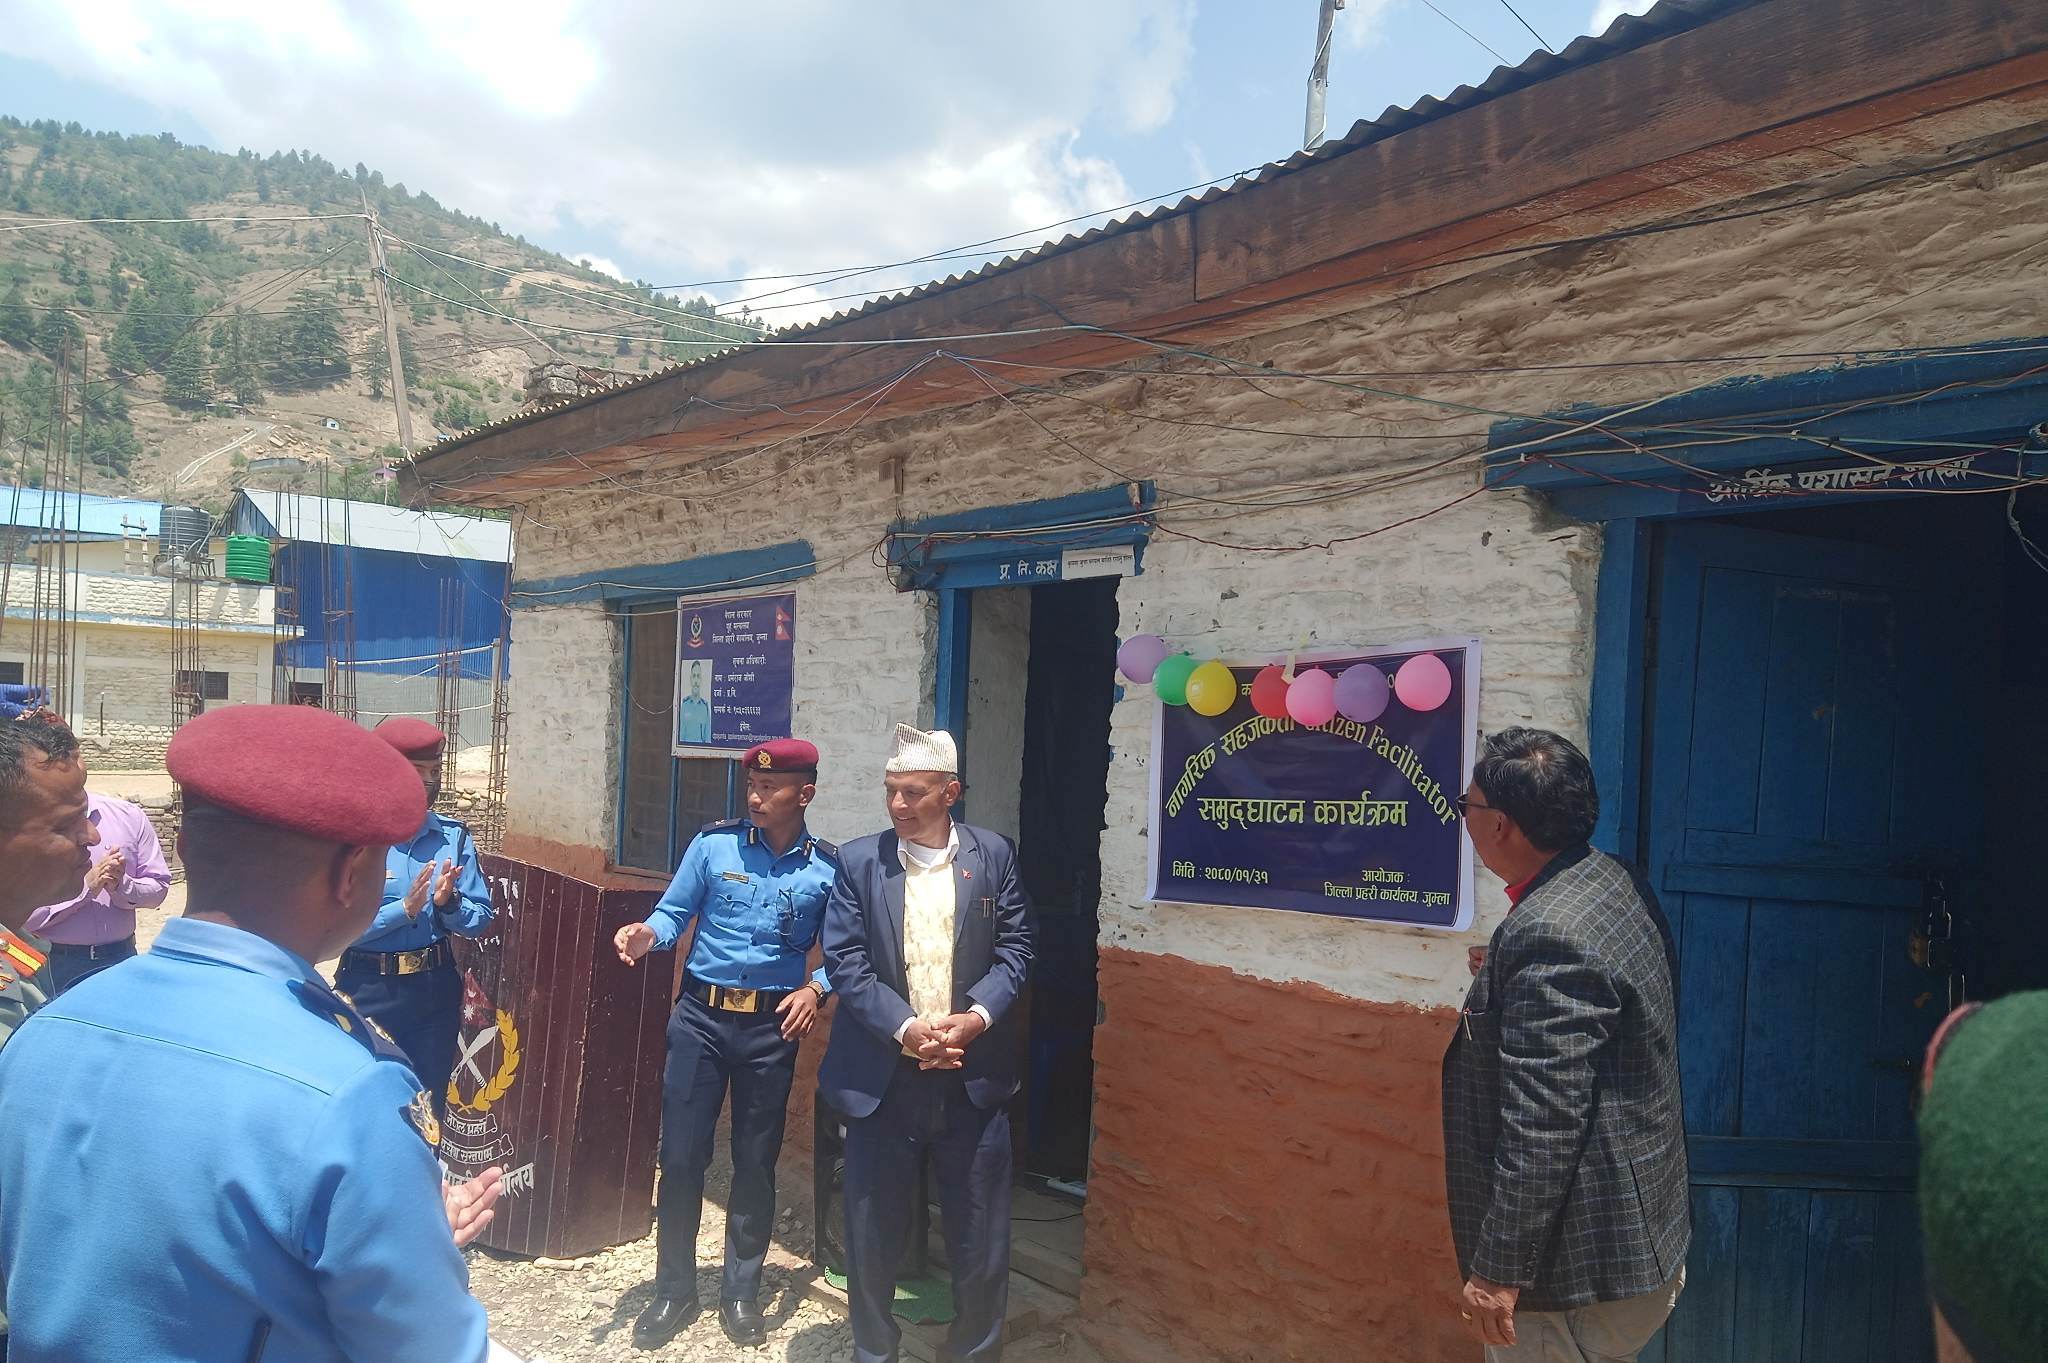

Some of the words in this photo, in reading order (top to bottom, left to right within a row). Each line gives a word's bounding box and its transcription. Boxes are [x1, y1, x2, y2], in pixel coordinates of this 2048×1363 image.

[1036, 560, 1058, 578] कक्ष
[1165, 743, 1216, 818] नागरिक
[1367, 725, 1457, 826] Facilitator
[1313, 790, 1409, 827] कार्यक्रम
[1172, 860, 1196, 879] मिति
[1205, 866, 1268, 885] २०८०/०१/३१
[1362, 867, 1405, 883] आयोजक
[1324, 881, 1353, 898] जिल्ला
[1355, 884, 1378, 900] प्रहरी
[1422, 891, 1450, 907] जुम्ला
